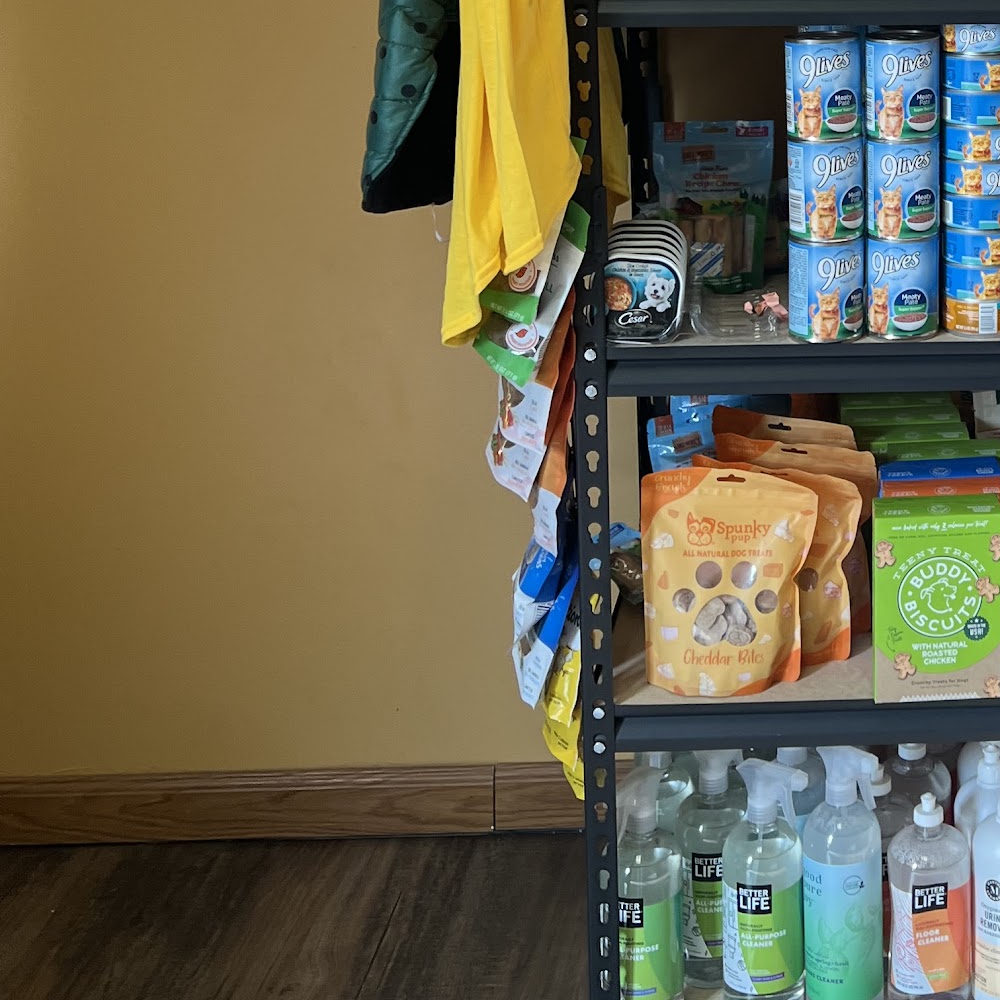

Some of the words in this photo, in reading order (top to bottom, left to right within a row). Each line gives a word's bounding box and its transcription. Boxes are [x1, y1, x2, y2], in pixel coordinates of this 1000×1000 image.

[835, 93, 853, 102] Meaty
[916, 93, 933, 102] Meaty
[901, 293, 921, 301] Meaty
[618, 311, 650, 326] Cesar
[716, 519, 771, 543] Spunky
[731, 535, 751, 544] pup
[682, 549, 695, 557] ALL
[696, 549, 730, 558] NATURAL
[730, 549, 747, 557] DOG
[748, 549, 773, 557] TREATS
[893, 547, 937, 580] TEENY
[943, 546, 986, 573] TREAT
[909, 562, 971, 589] BUDDY
[904, 596, 977, 632] BISCUITS
[912, 643, 932, 651] WITH
[932, 641, 968, 649] NATURAL
[683, 649, 733, 666] Cheddar
[737, 648, 765, 664] Bites
[922, 649, 958, 658] ROASTED
[923, 657, 957, 665] CHICKEN
[694, 865, 723, 878] LIFE
[738, 887, 769, 898] BETTER
[914, 885, 945, 897] BETTER
[739, 897, 771, 911] LIFE
[914, 892, 946, 910] LIFE
[740, 929, 787, 940] ALL-PURPOSE
[915, 929, 940, 939] FLOOR
[742, 940, 773, 948] CLEANER
[917, 935, 949, 946] CLEANER
